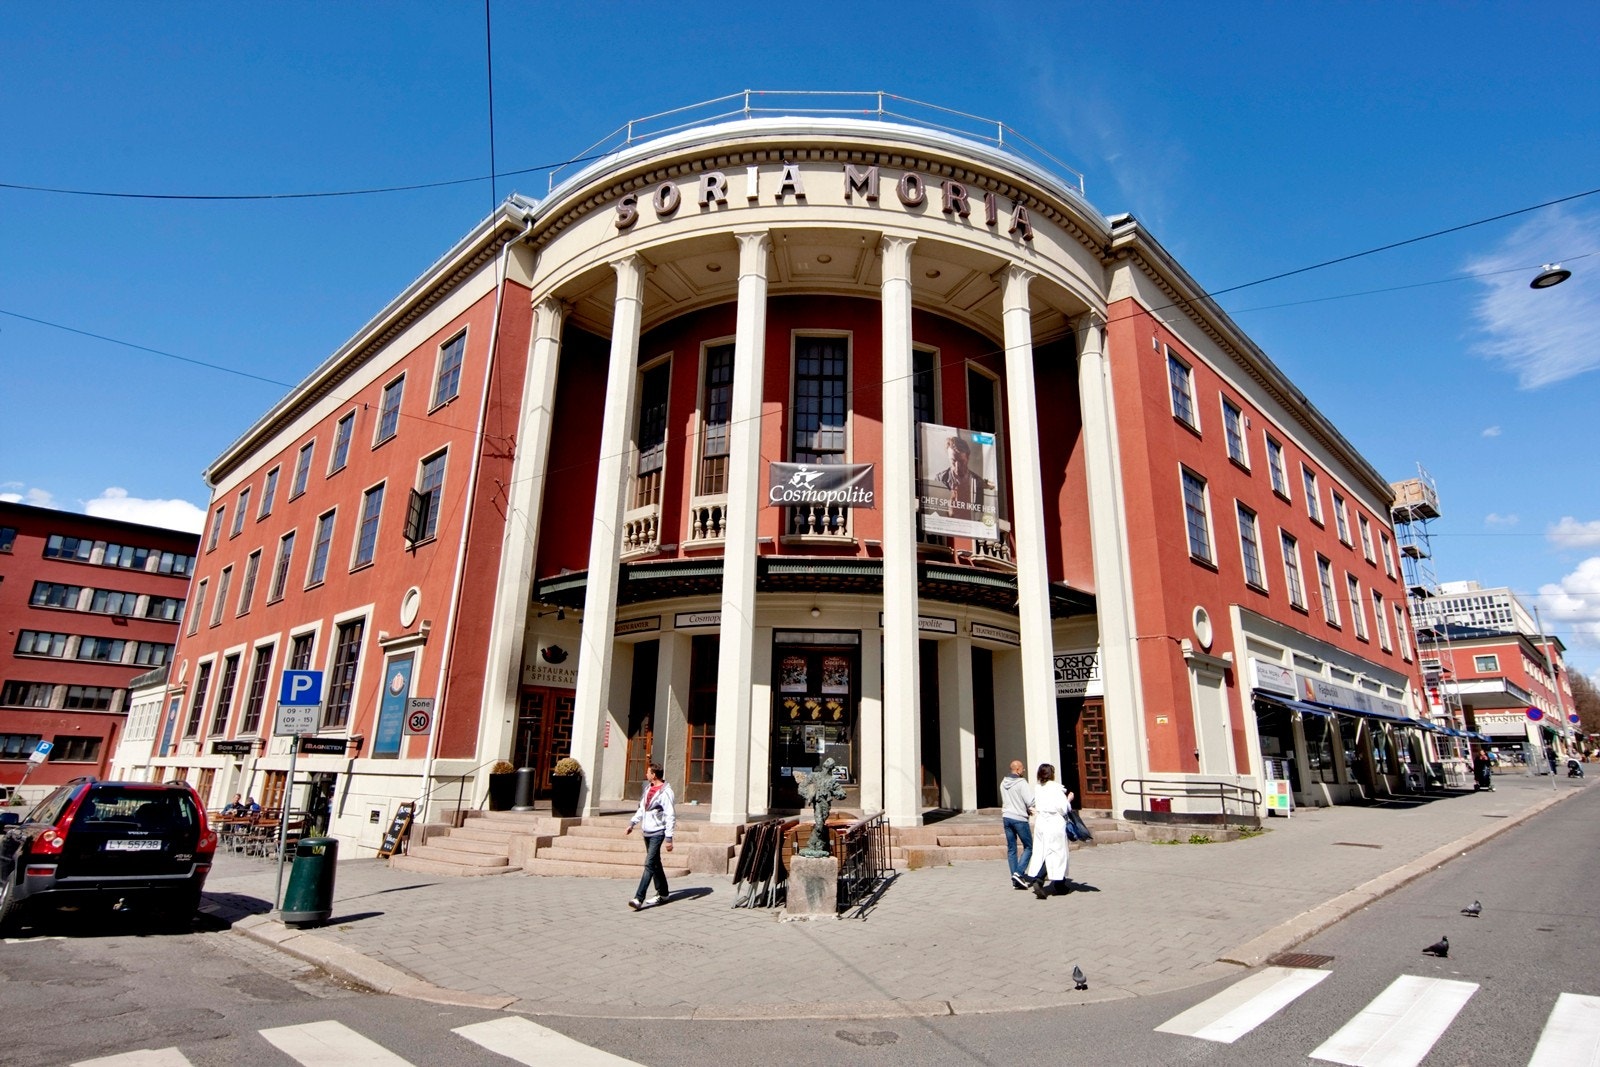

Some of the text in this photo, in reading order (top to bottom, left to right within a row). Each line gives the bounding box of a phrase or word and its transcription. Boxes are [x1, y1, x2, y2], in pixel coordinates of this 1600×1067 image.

[614, 163, 1035, 242] SORIA MORIA
[769, 484, 874, 507] Cosmopolite
[921, 496, 939, 506] CHET
[939, 498, 966, 509] SPILLER
[966, 503, 982, 512] IKKE
[982, 505, 996, 514] HER
[531, 673, 574, 684] SPISESAL
[1061, 667, 1099, 681] TEATRET
[290, 675, 313, 701] P
[412, 700, 431, 708] Sone
[412, 716, 426, 727] 30
[1490, 715, 1524, 723] HANSEN
[39, 743, 49, 751] P
[109, 840, 159, 849] LY 55738
